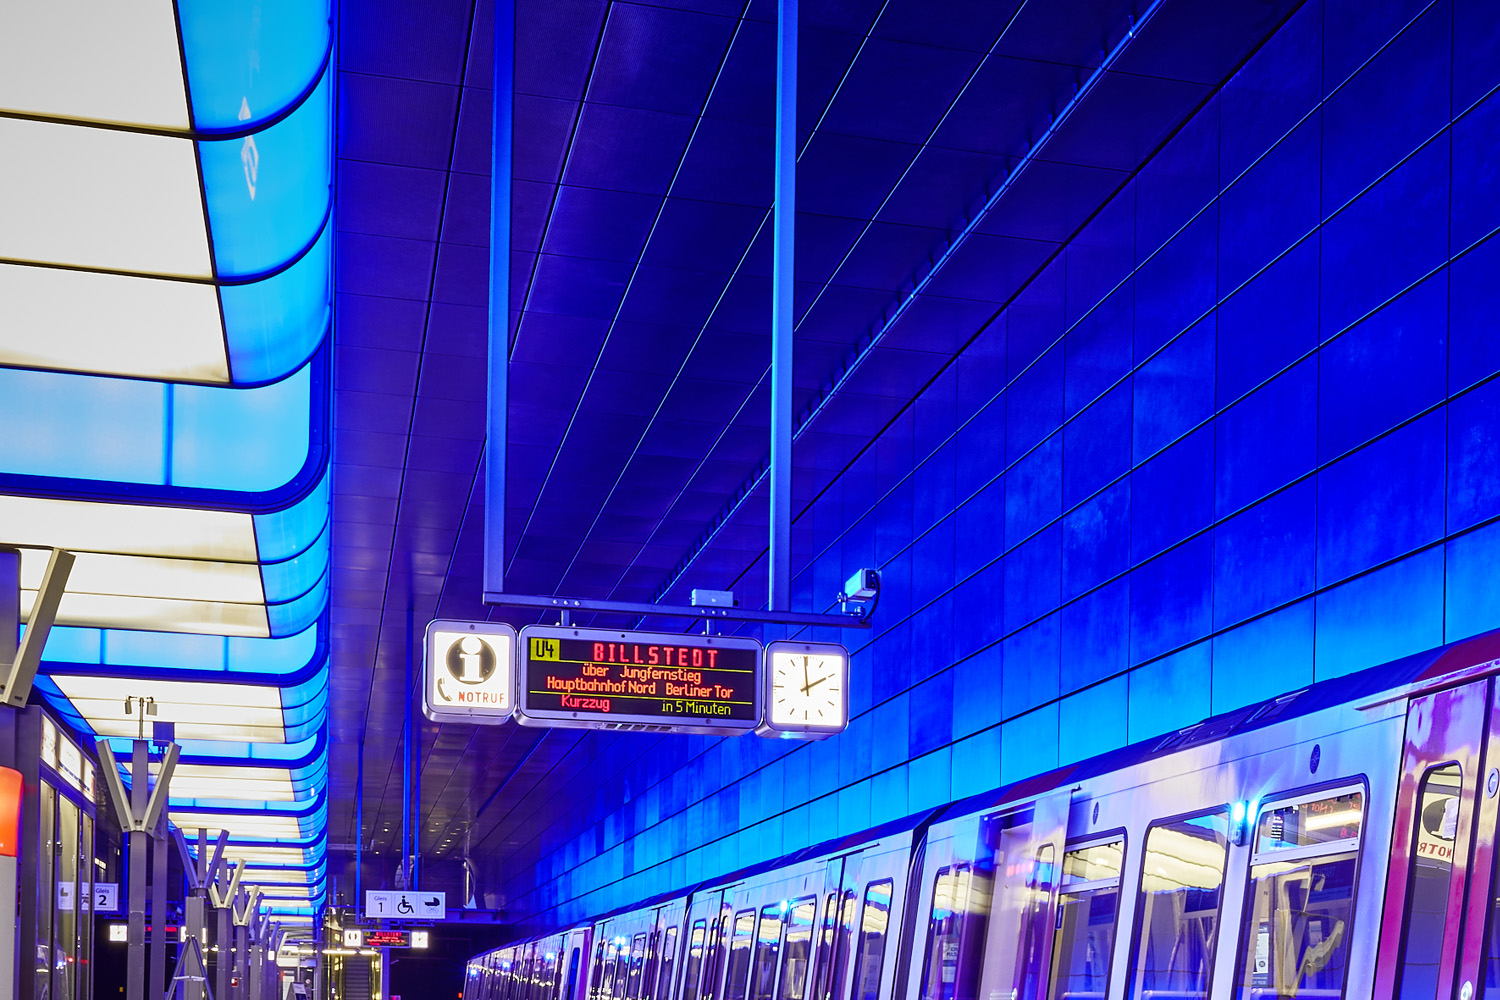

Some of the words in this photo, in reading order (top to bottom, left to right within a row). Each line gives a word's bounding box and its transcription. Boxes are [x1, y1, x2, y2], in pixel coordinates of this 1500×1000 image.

[536, 640, 555, 658] U4
[594, 643, 719, 668] BILLSTEDT
[582, 664, 609, 677] über
[620, 665, 701, 685] Jungfernstieg
[458, 691, 505, 704] NOTRUF
[547, 676, 626, 693] Hauptbahnhof
[628, 682, 656, 695] Nord
[665, 682, 713, 697] Berliner
[714, 685, 733, 699] Tor
[561, 694, 611, 712] Kurzzug
[662, 700, 673, 712] in
[675, 701, 683, 714] 5
[685, 702, 731, 716] Minuten
[98, 895, 107, 905] 2
